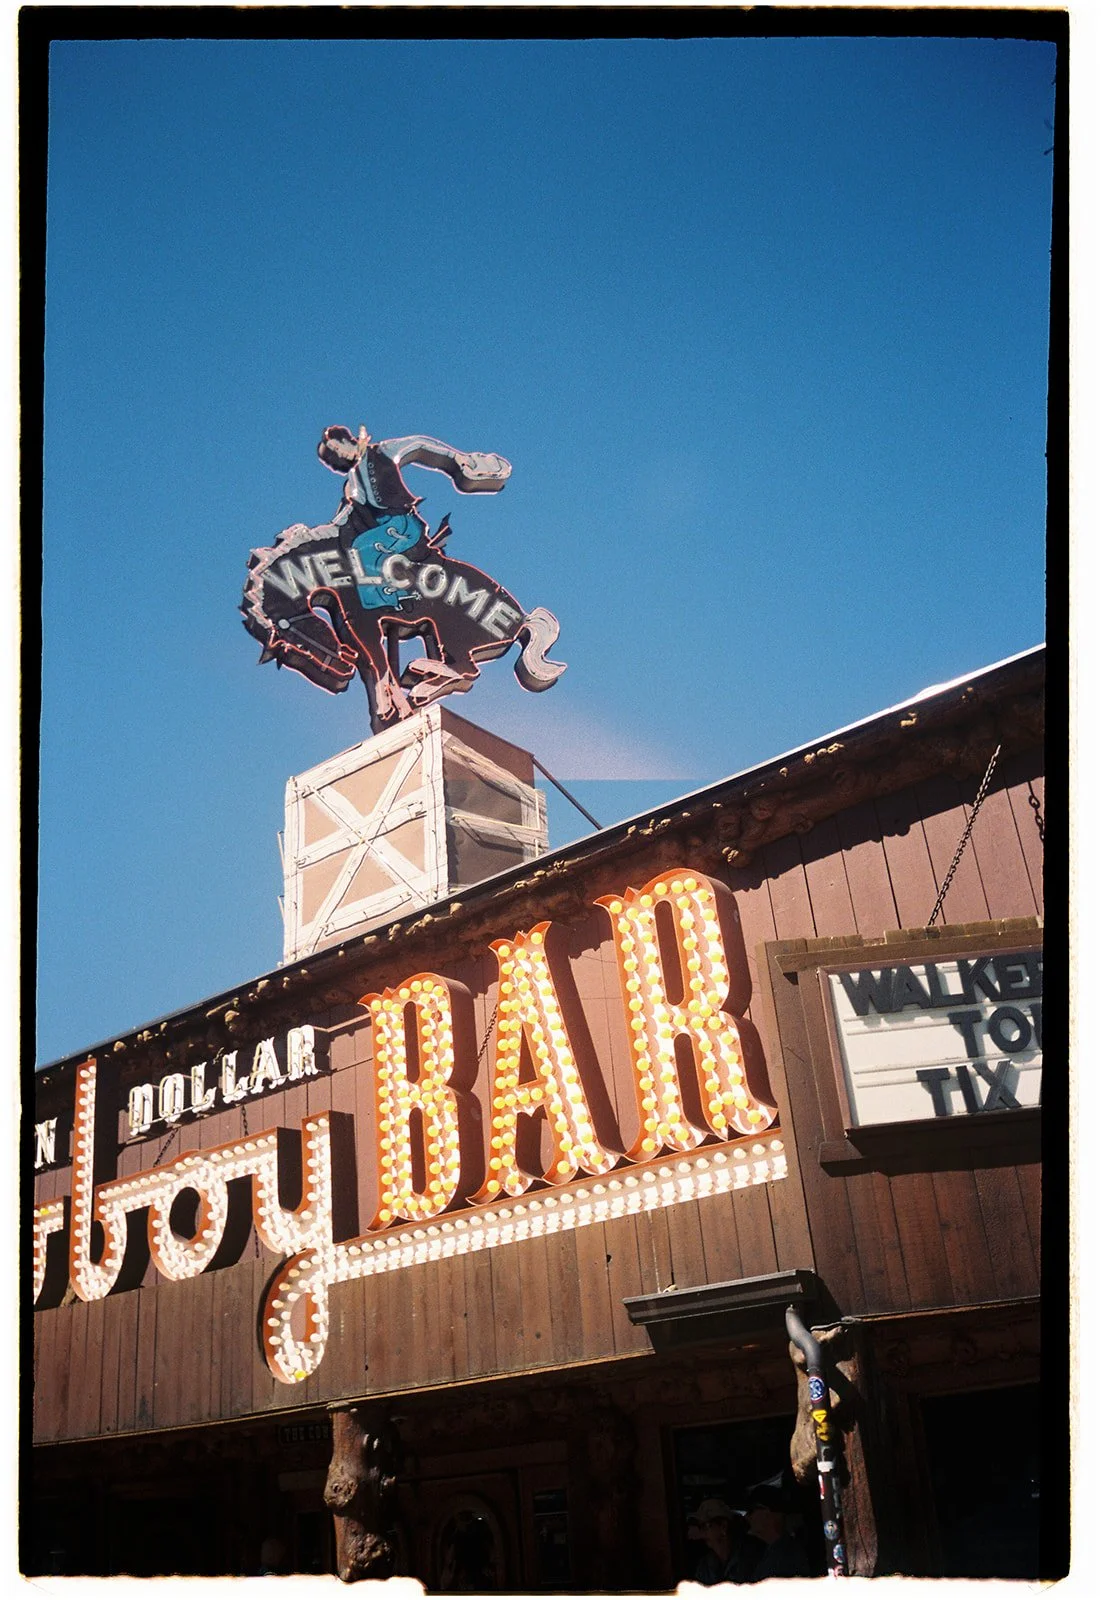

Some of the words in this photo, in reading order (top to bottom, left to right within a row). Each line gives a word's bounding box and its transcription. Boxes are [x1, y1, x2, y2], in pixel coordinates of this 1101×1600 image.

[261, 549, 523, 640] WELCOME
[128, 1025, 319, 1136] DOLLAR
[357, 868, 778, 1232] BAR
[916, 1060, 1021, 1116] TIX
